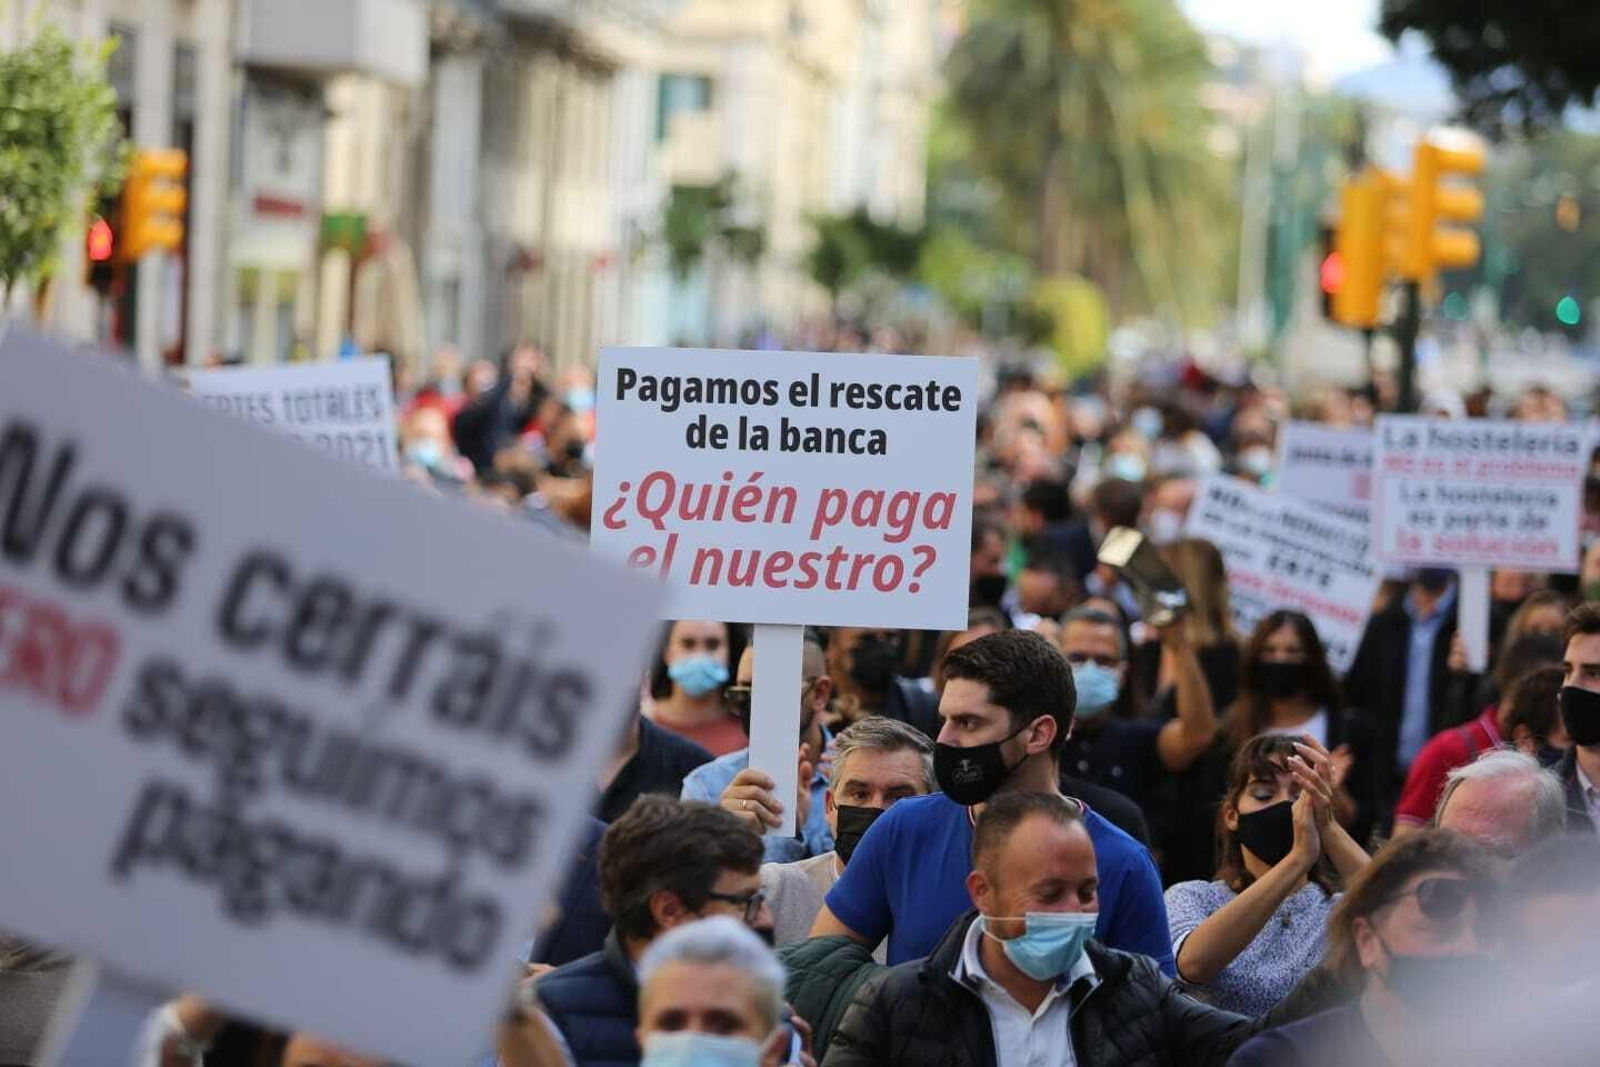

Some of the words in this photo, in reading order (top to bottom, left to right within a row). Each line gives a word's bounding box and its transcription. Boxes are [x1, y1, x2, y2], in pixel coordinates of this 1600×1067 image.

[616, 368, 779, 412] Pagamos
[788, 373, 820, 407] el
[830, 380, 962, 412] rescate
[685, 415, 728, 450] de
[738, 416, 769, 451] la
[779, 418, 888, 455] banca
[1383, 426, 1419, 449] La
[603, 471, 798, 531] ¿Quién
[810, 488, 958, 544] paga
[1399, 480, 1430, 502] La
[0, 419, 199, 618] Nos
[626, 533, 679, 579] el
[689, 545, 937, 594] nuestro?
[109, 776, 506, 974] pagando
